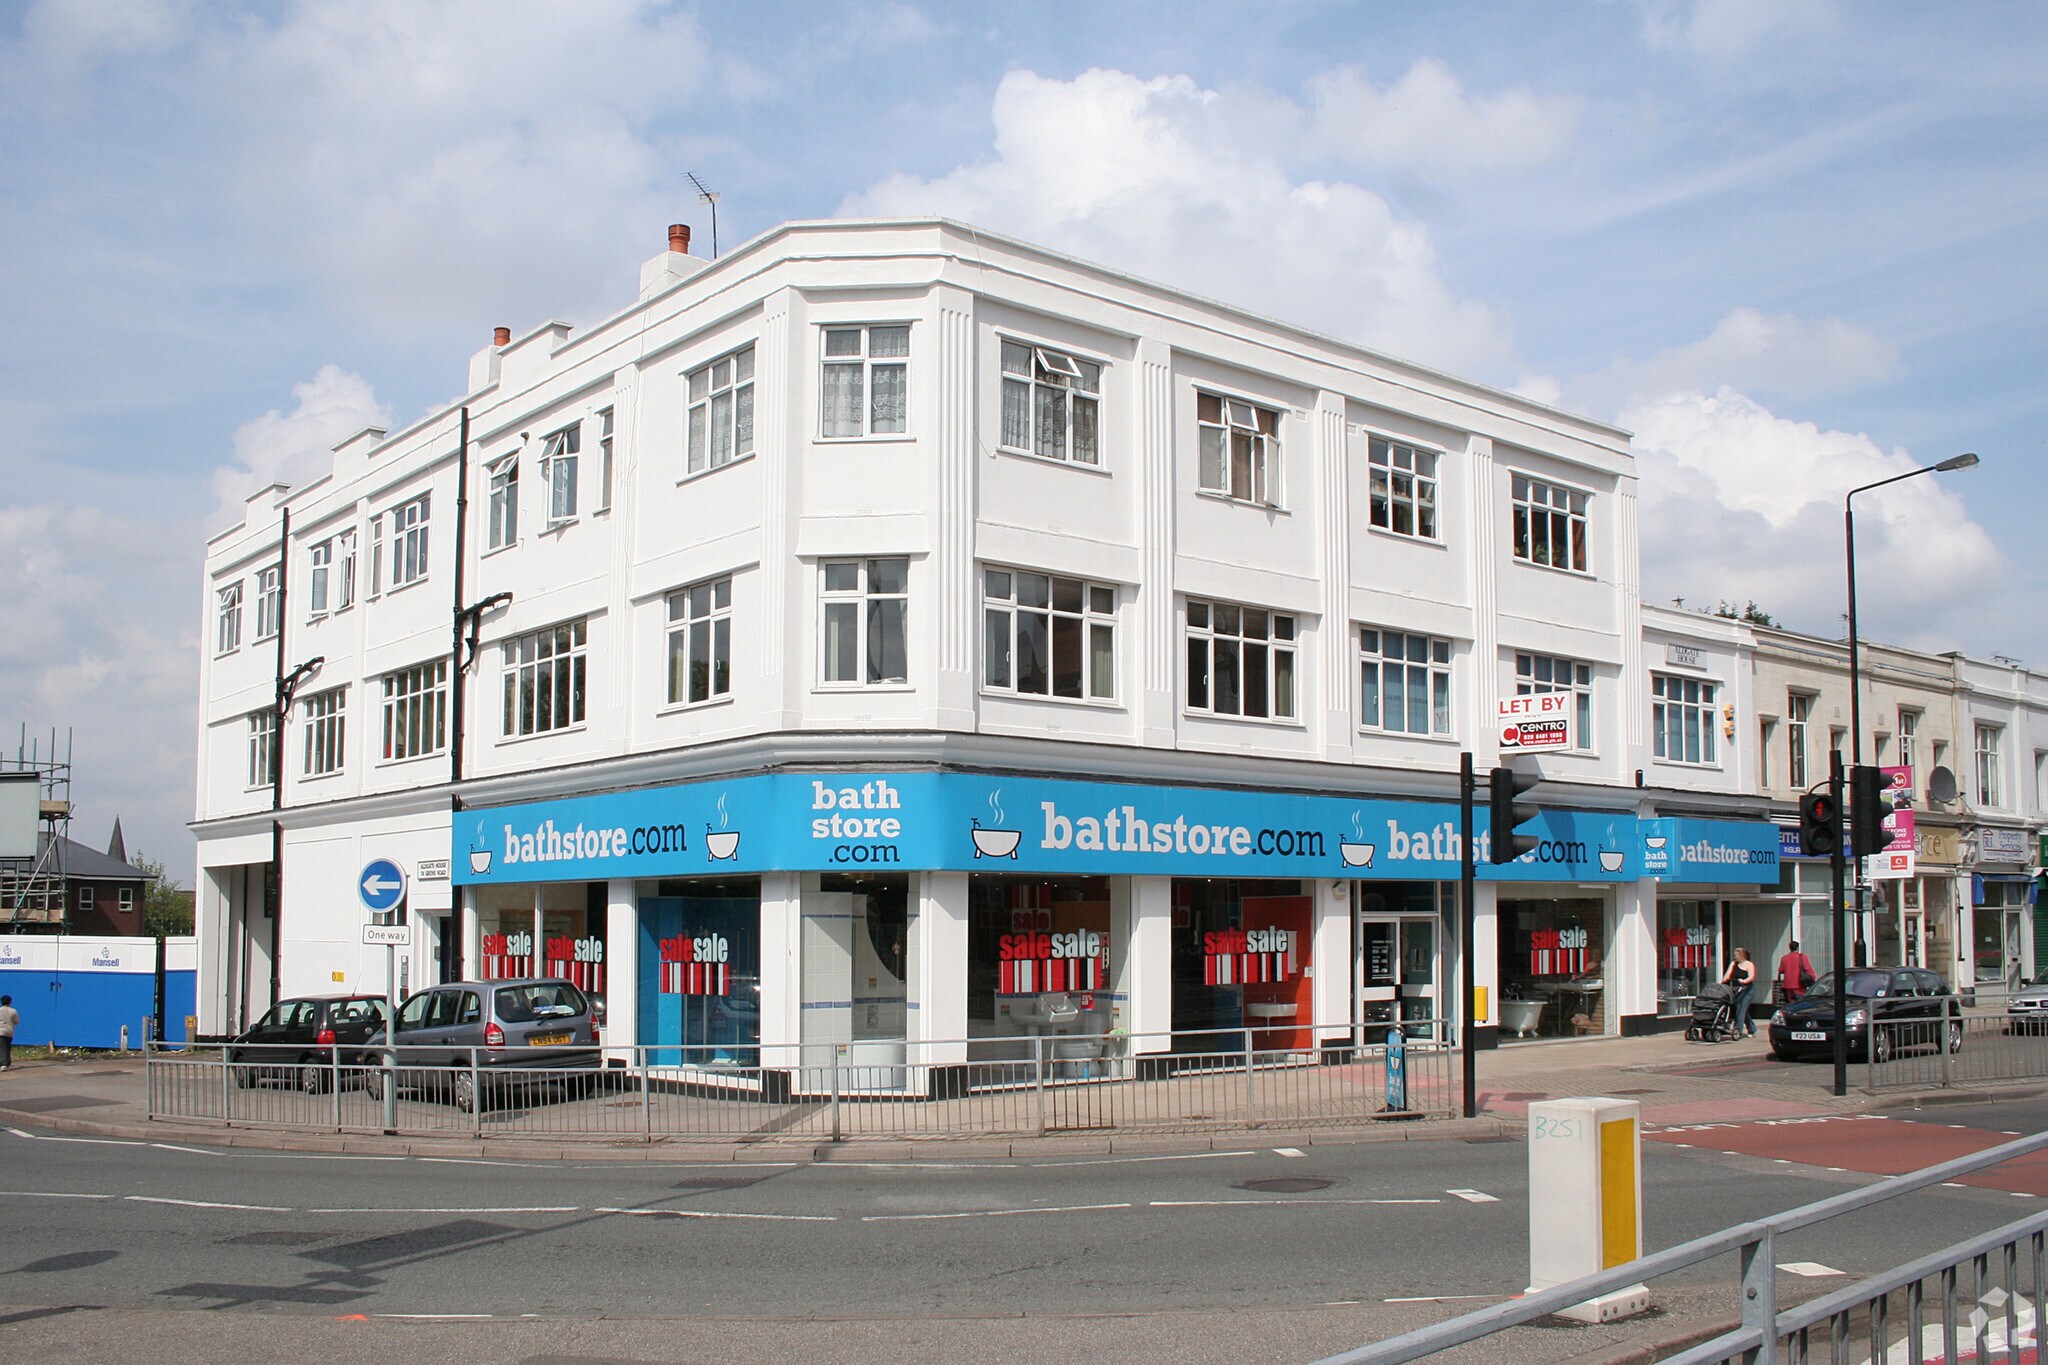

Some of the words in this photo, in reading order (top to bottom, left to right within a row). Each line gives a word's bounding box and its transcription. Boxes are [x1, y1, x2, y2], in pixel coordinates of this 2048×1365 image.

[1499, 699, 1533, 714] LET
[1541, 696, 1565, 711] BY
[811, 780, 901, 810] bath
[812, 812, 901, 838] store
[1041, 801, 1326, 857] bathstore.com
[503, 820, 688, 864] bathstore.com
[1387, 820, 1588, 864] bathst.com
[1778, 831, 1800, 844] EITH
[828, 844, 900, 863] .com
[1644, 850, 1668, 860] bath
[1644, 860, 1668, 869] store
[368, 930, 386, 939] One
[387, 932, 406, 942] way
[0, 956, 21, 965] ansell
[92, 957, 120, 967] Mansell
